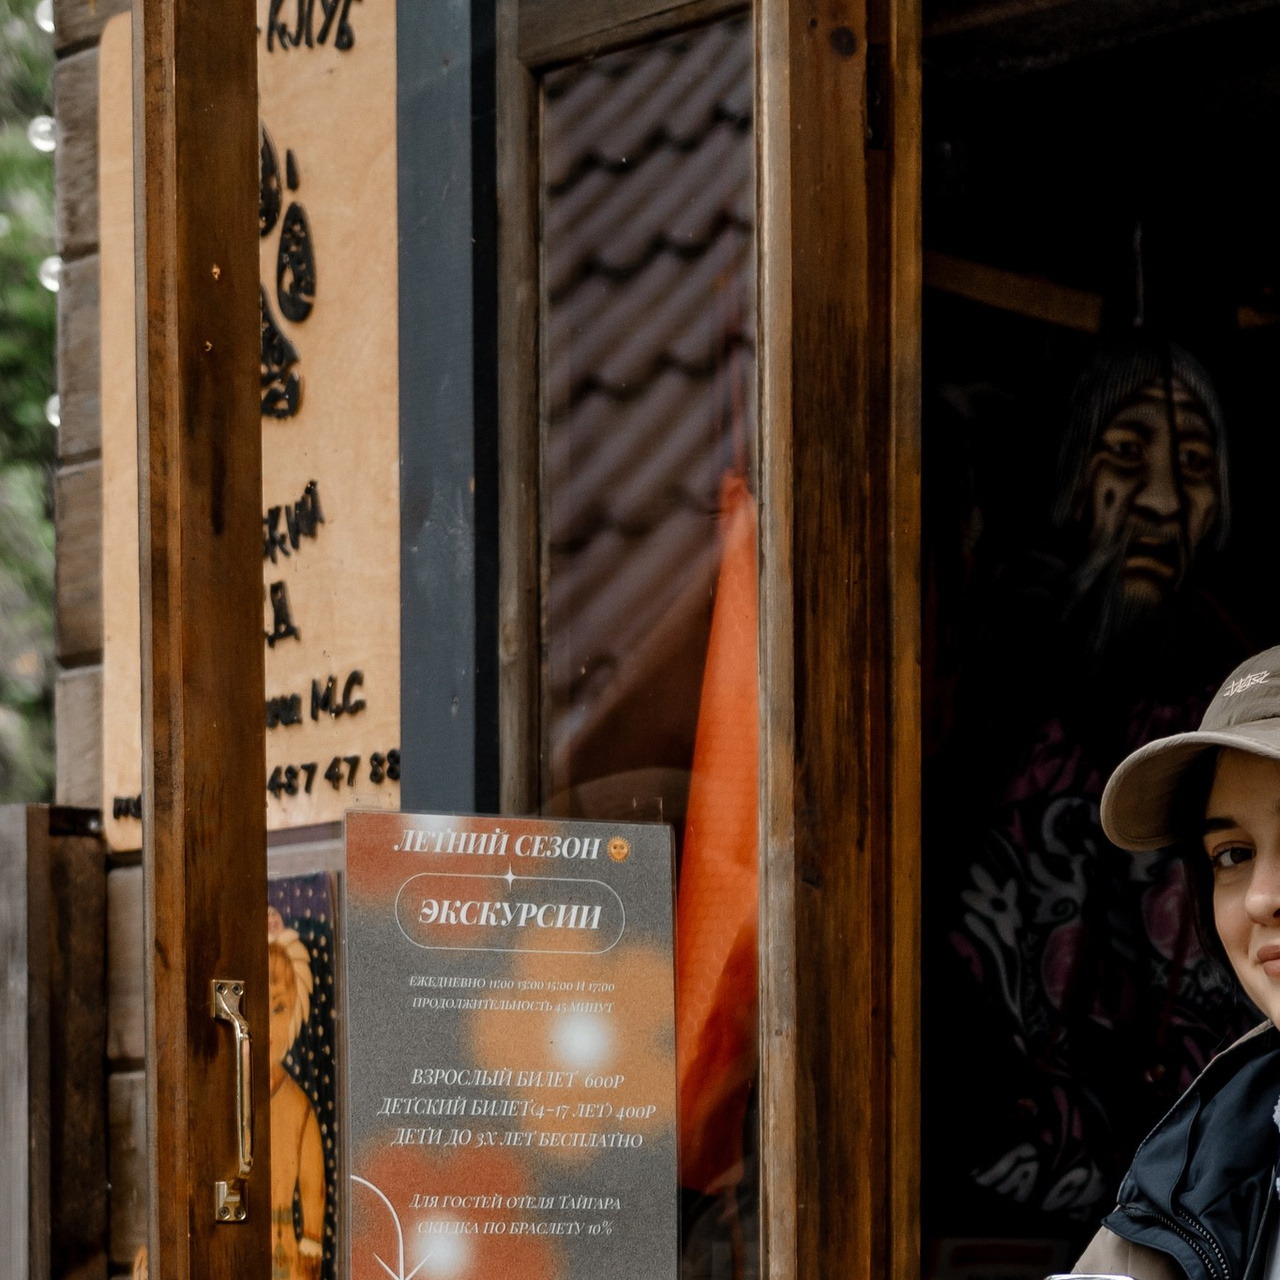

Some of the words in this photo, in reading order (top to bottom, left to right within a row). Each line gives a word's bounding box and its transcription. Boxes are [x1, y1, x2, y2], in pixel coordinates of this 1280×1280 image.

[325, 755, 360, 790] 47
[394, 828, 510, 856] ЛЕТНИЙ
[515, 834, 602, 860] СЕЗОН
[419, 899, 602, 929] ЭКСКУРСИИ
[409, 976, 486, 989] ЕЖЕДНЕВНО
[412, 997, 553, 1012] ПРОДОЛЖИТЕЛЬНОСТЬ
[570, 1001, 615, 1013] МИНУТ
[411, 1067, 513, 1087] ВЗРОСЛЫЙ
[516, 1070, 579, 1088] БИЛЕТ
[584, 1073, 625, 1089] 600Р
[377, 1096, 468, 1116] ДЕТСКИЙ
[572, 1103, 613, 1118] ЛЕТ)
[615, 1104, 657, 1121] 400Р
[390, 1126, 443, 1146] ДЕТИ
[444, 1128, 472, 1147] ДО
[499, 1130, 537, 1146] ЛЕТ
[538, 1131, 643, 1149] БЕСПЛАТНО
[442, 1193, 504, 1209] ГОСТЕЙ
[506, 1195, 554, 1210] ОТЕЛЯ
[559, 1194, 621, 1210] ТАЙГАРА
[417, 1221, 479, 1236] СКИДКА
[484, 1222, 506, 1235] ПО
[509, 1222, 585, 1236] БРАСЛЕТУ
[588, 1219, 614, 1236] 10%
